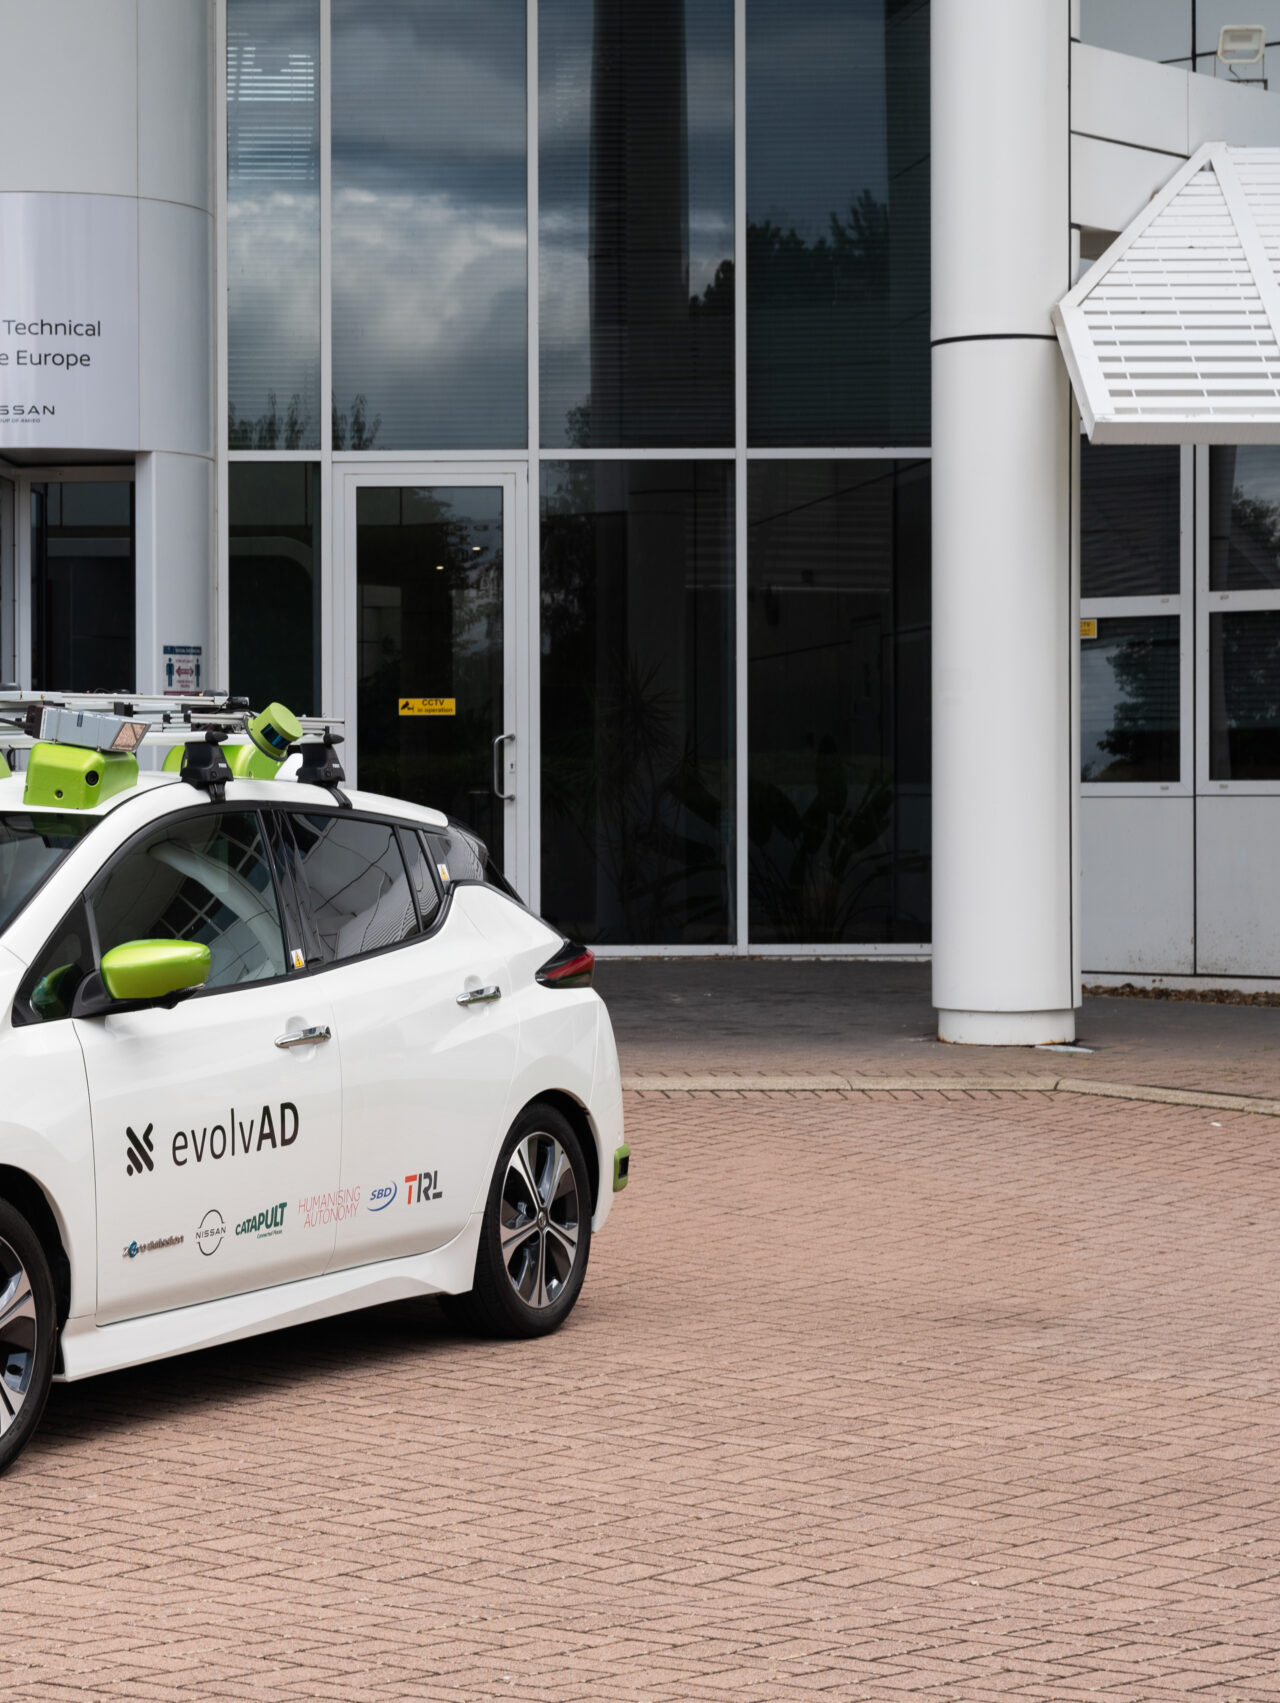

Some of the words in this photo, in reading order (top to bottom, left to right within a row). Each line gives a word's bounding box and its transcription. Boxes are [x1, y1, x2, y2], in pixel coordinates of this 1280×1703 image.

[2, 319, 101, 338] Technical
[16, 350, 91, 370] Europe
[172, 1101, 299, 1167] evolvAD
[298, 1185, 361, 1214] HUMANISING
[370, 1187, 392, 1201] SBD
[404, 1170, 443, 1205] TRL
[235, 1202, 287, 1236] CATAPULT
[303, 1203, 359, 1229] AUTONOMY
[195, 1226, 226, 1239] NISSAN
